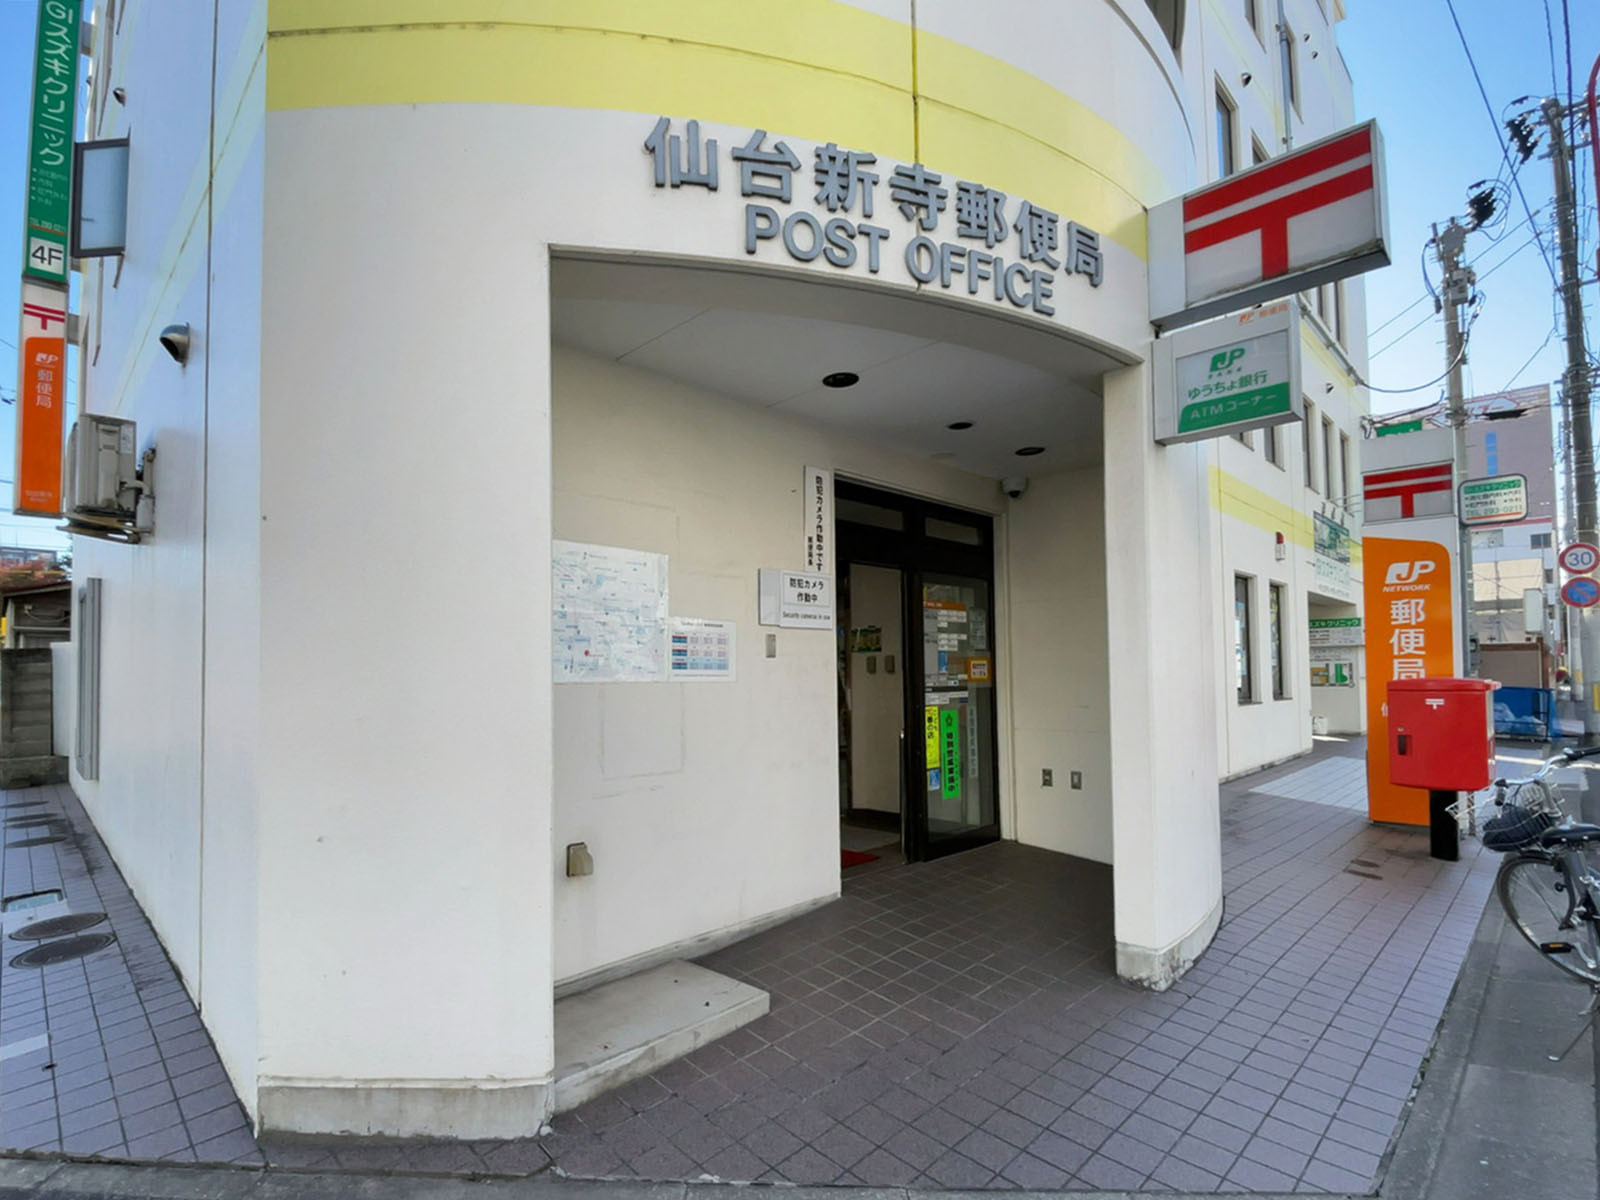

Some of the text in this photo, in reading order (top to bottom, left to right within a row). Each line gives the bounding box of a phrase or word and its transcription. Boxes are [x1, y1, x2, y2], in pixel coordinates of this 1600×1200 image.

[644, 116, 1103, 288] 仙台新寺郵便局
[31, 246, 63, 266] 4F
[745, 204, 1055, 316] POST OFFICE
[35, 369, 54, 409] 郵便局
[1188, 370, 1267, 400] ゆうちょ銀行
[1568, 551, 1593, 566] 30
[789, 577, 824, 591] 防犯カメラ
[1385, 560, 1435, 584] JP
[797, 591, 818, 603] 作動中
[1383, 584, 1431, 592] NETWORK
[1389, 598, 1426, 680] 郵便局
